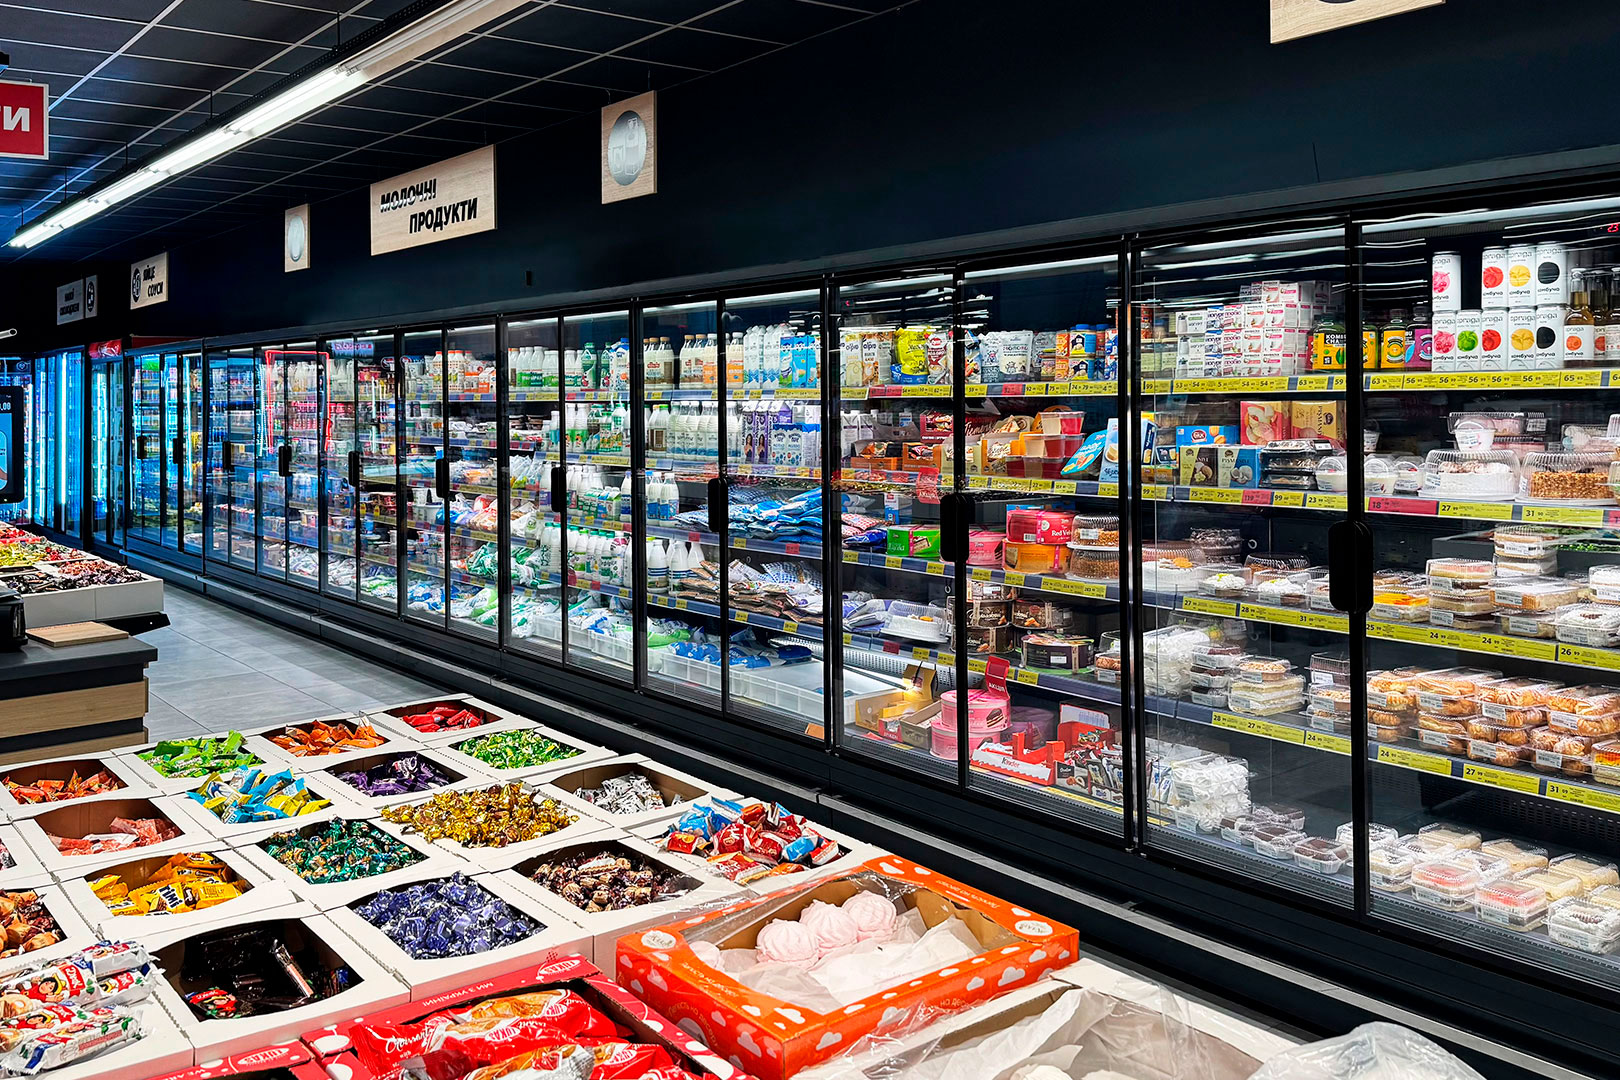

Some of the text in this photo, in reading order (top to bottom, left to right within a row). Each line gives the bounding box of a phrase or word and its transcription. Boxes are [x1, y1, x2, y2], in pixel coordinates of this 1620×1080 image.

[380, 178, 437, 213] МОЛОЧНІ
[409, 197, 478, 233] ПРОДУКТИ
[1561, 648, 1572, 656] 26
[385, 1026, 431, 1053] Croissant
[488, 1027, 517, 1040] LUKAS
